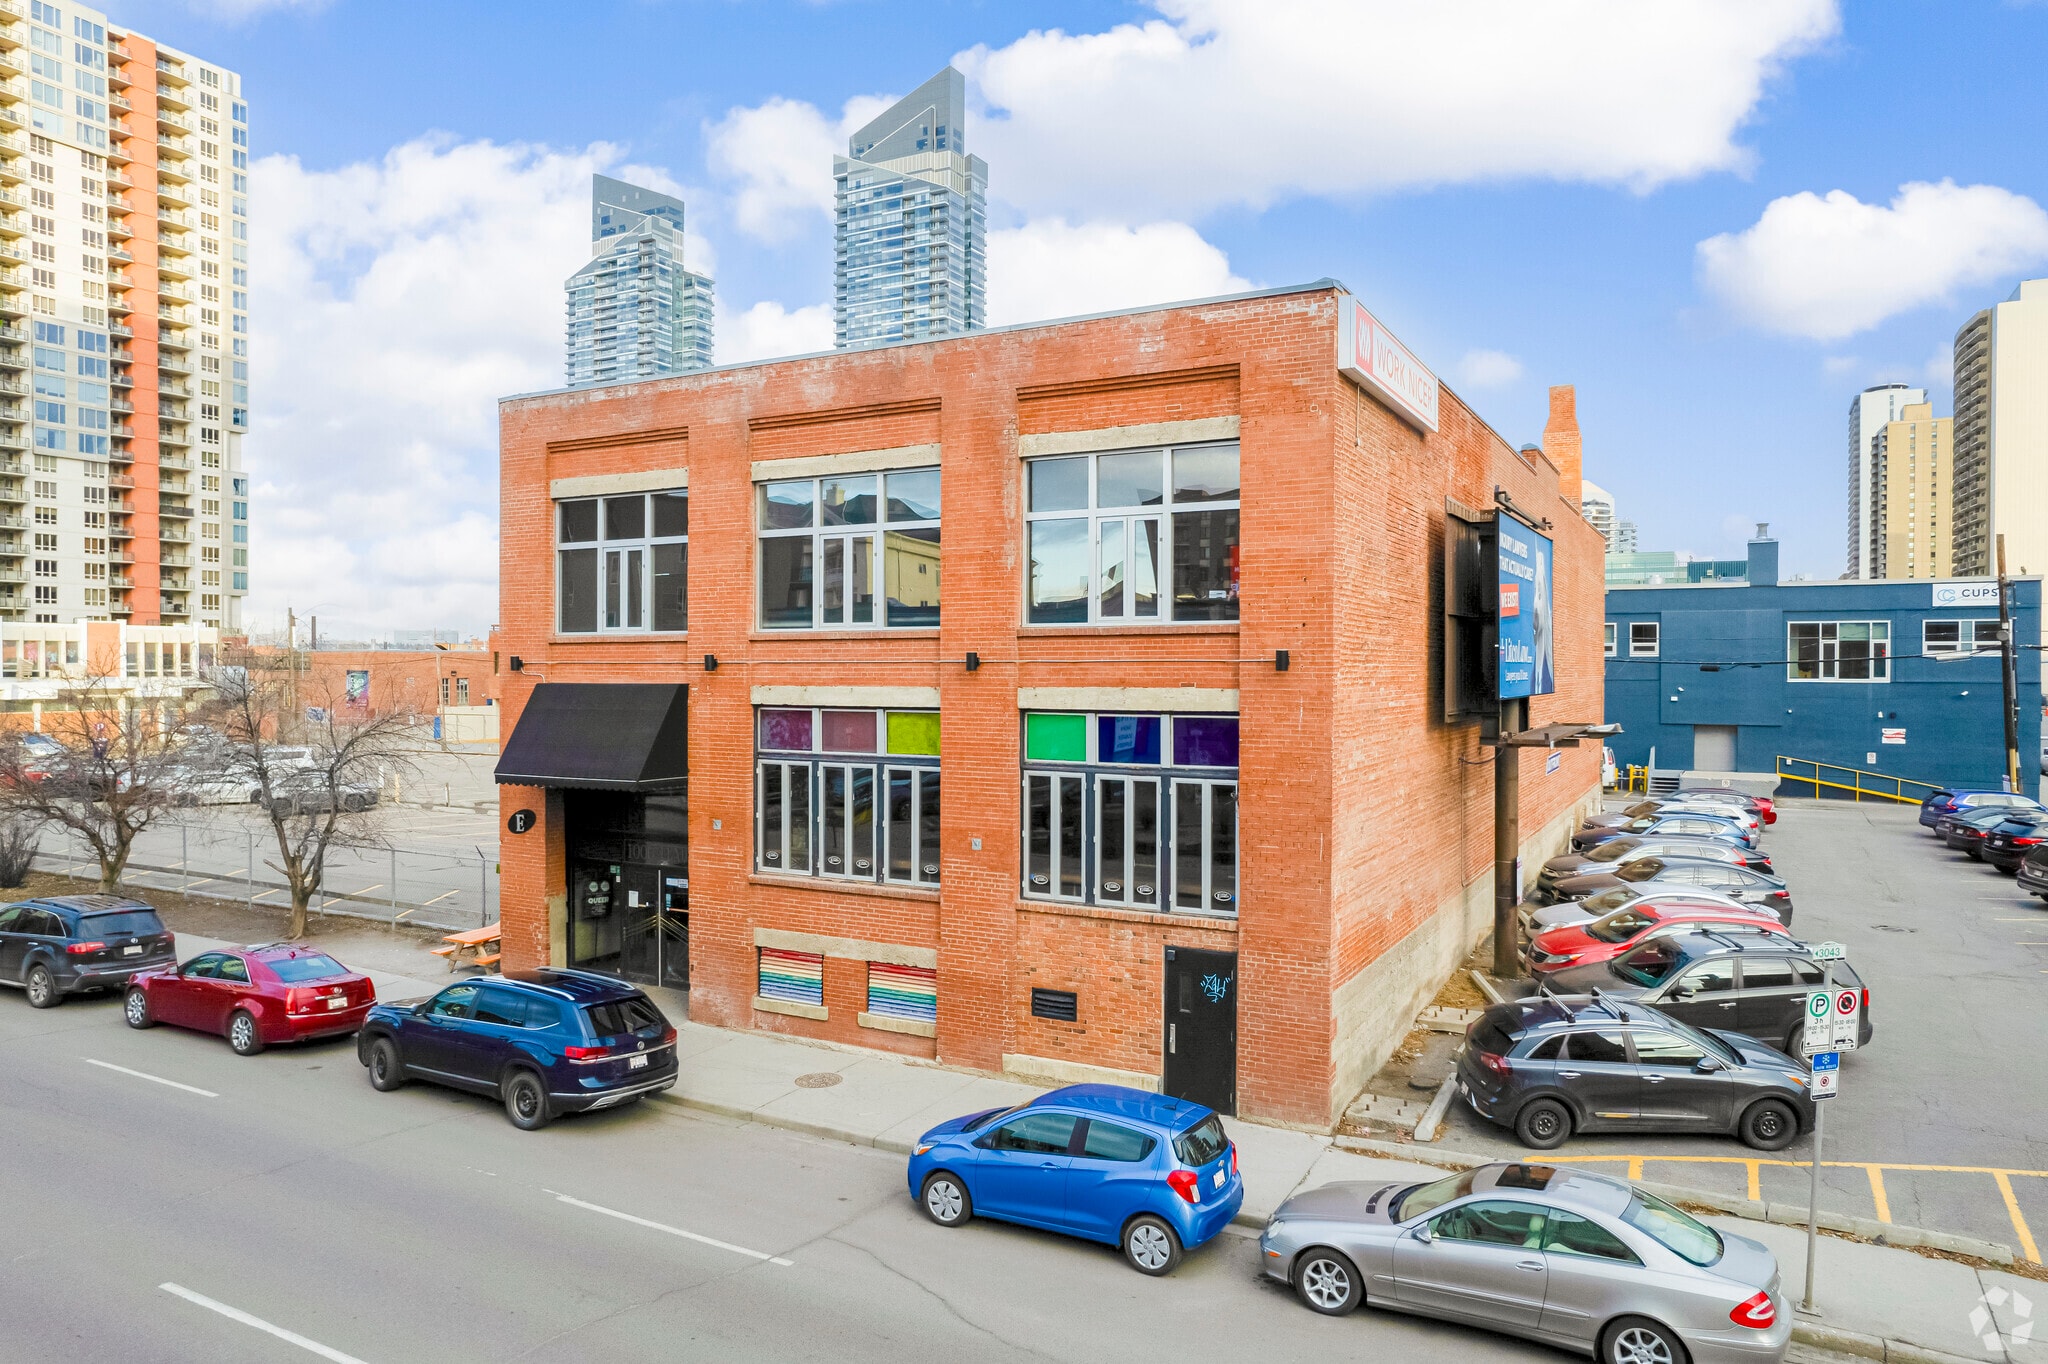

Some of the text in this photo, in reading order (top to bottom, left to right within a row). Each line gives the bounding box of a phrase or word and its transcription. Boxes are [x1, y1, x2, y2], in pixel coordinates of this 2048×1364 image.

[1376, 338, 1433, 412] WORK NICER
[1513, 539, 1528, 559] LAWYERS
[1501, 592, 1508, 608] WE
[1961, 588, 1998, 597] CUPS
[515, 814, 525, 832] E
[1818, 947, 1841, 958] 3043
